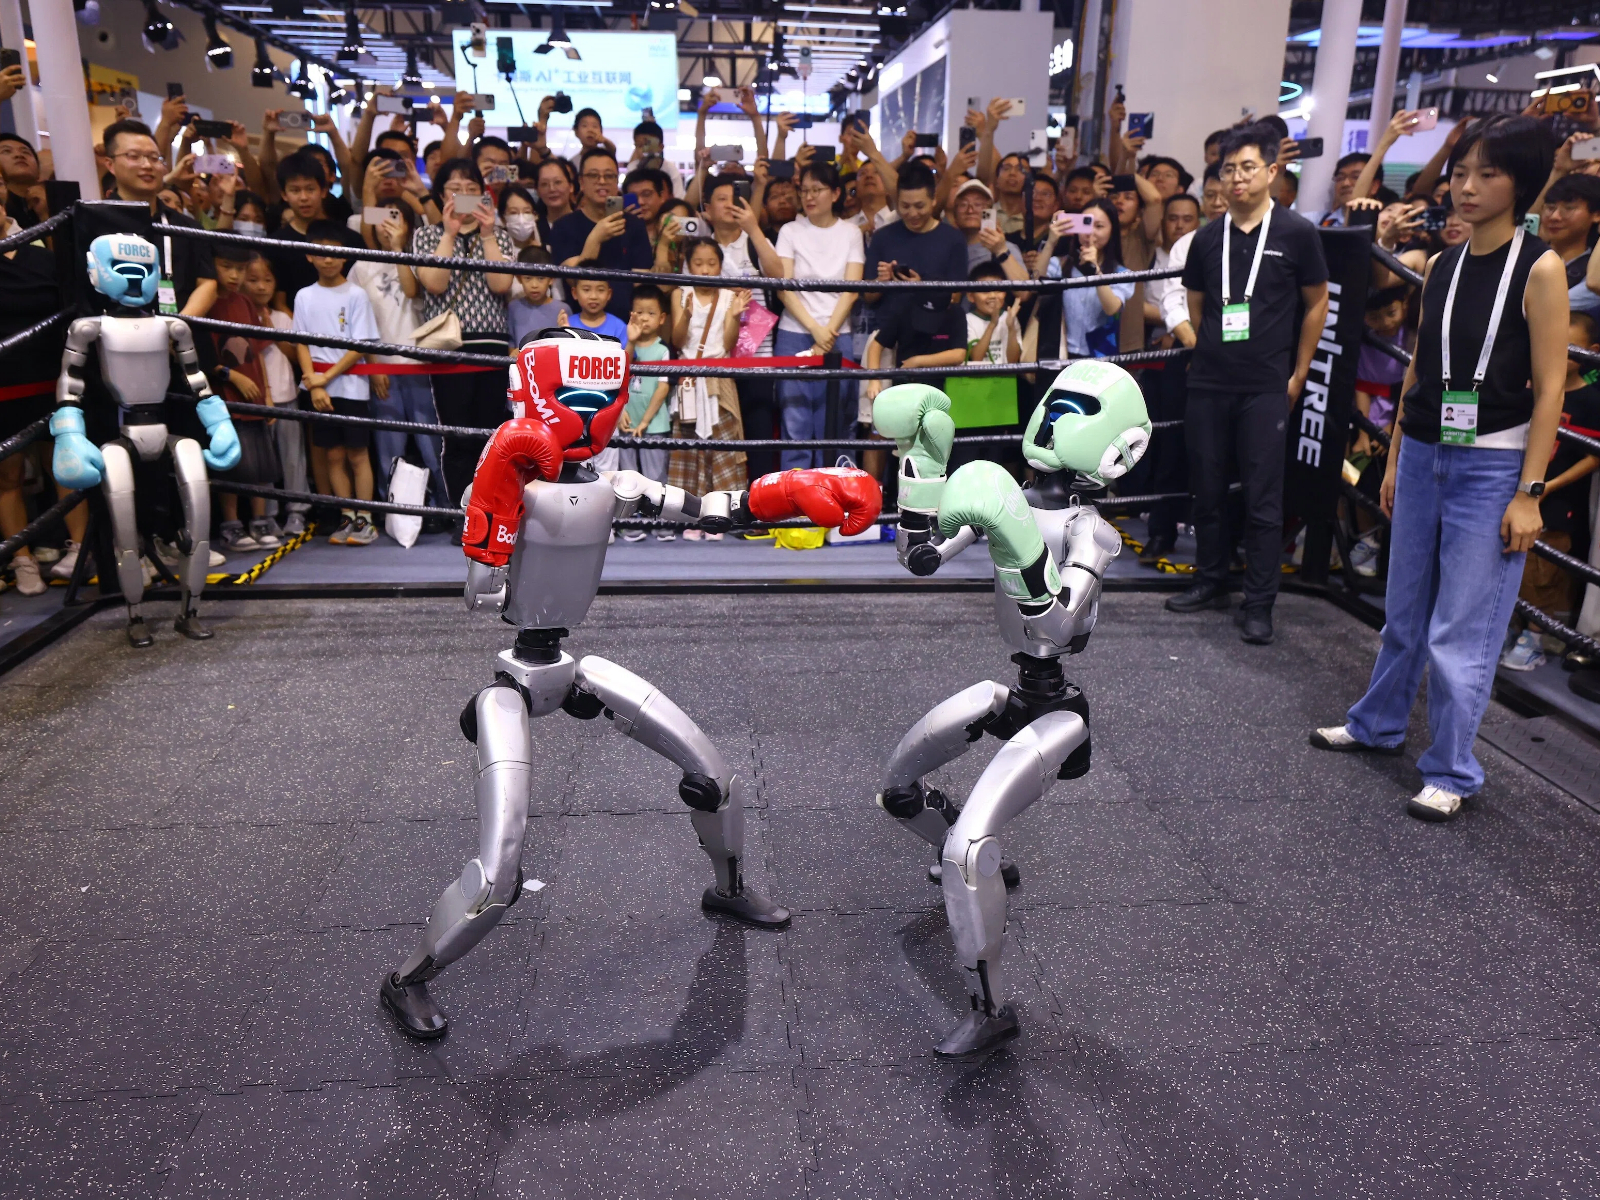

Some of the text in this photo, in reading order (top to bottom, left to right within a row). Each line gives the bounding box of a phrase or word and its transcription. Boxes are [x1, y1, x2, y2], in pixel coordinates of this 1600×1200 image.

[563, 71, 632, 85] 工业互联网
[118, 243, 151, 258] FORCE
[568, 355, 621, 380] FORCE
